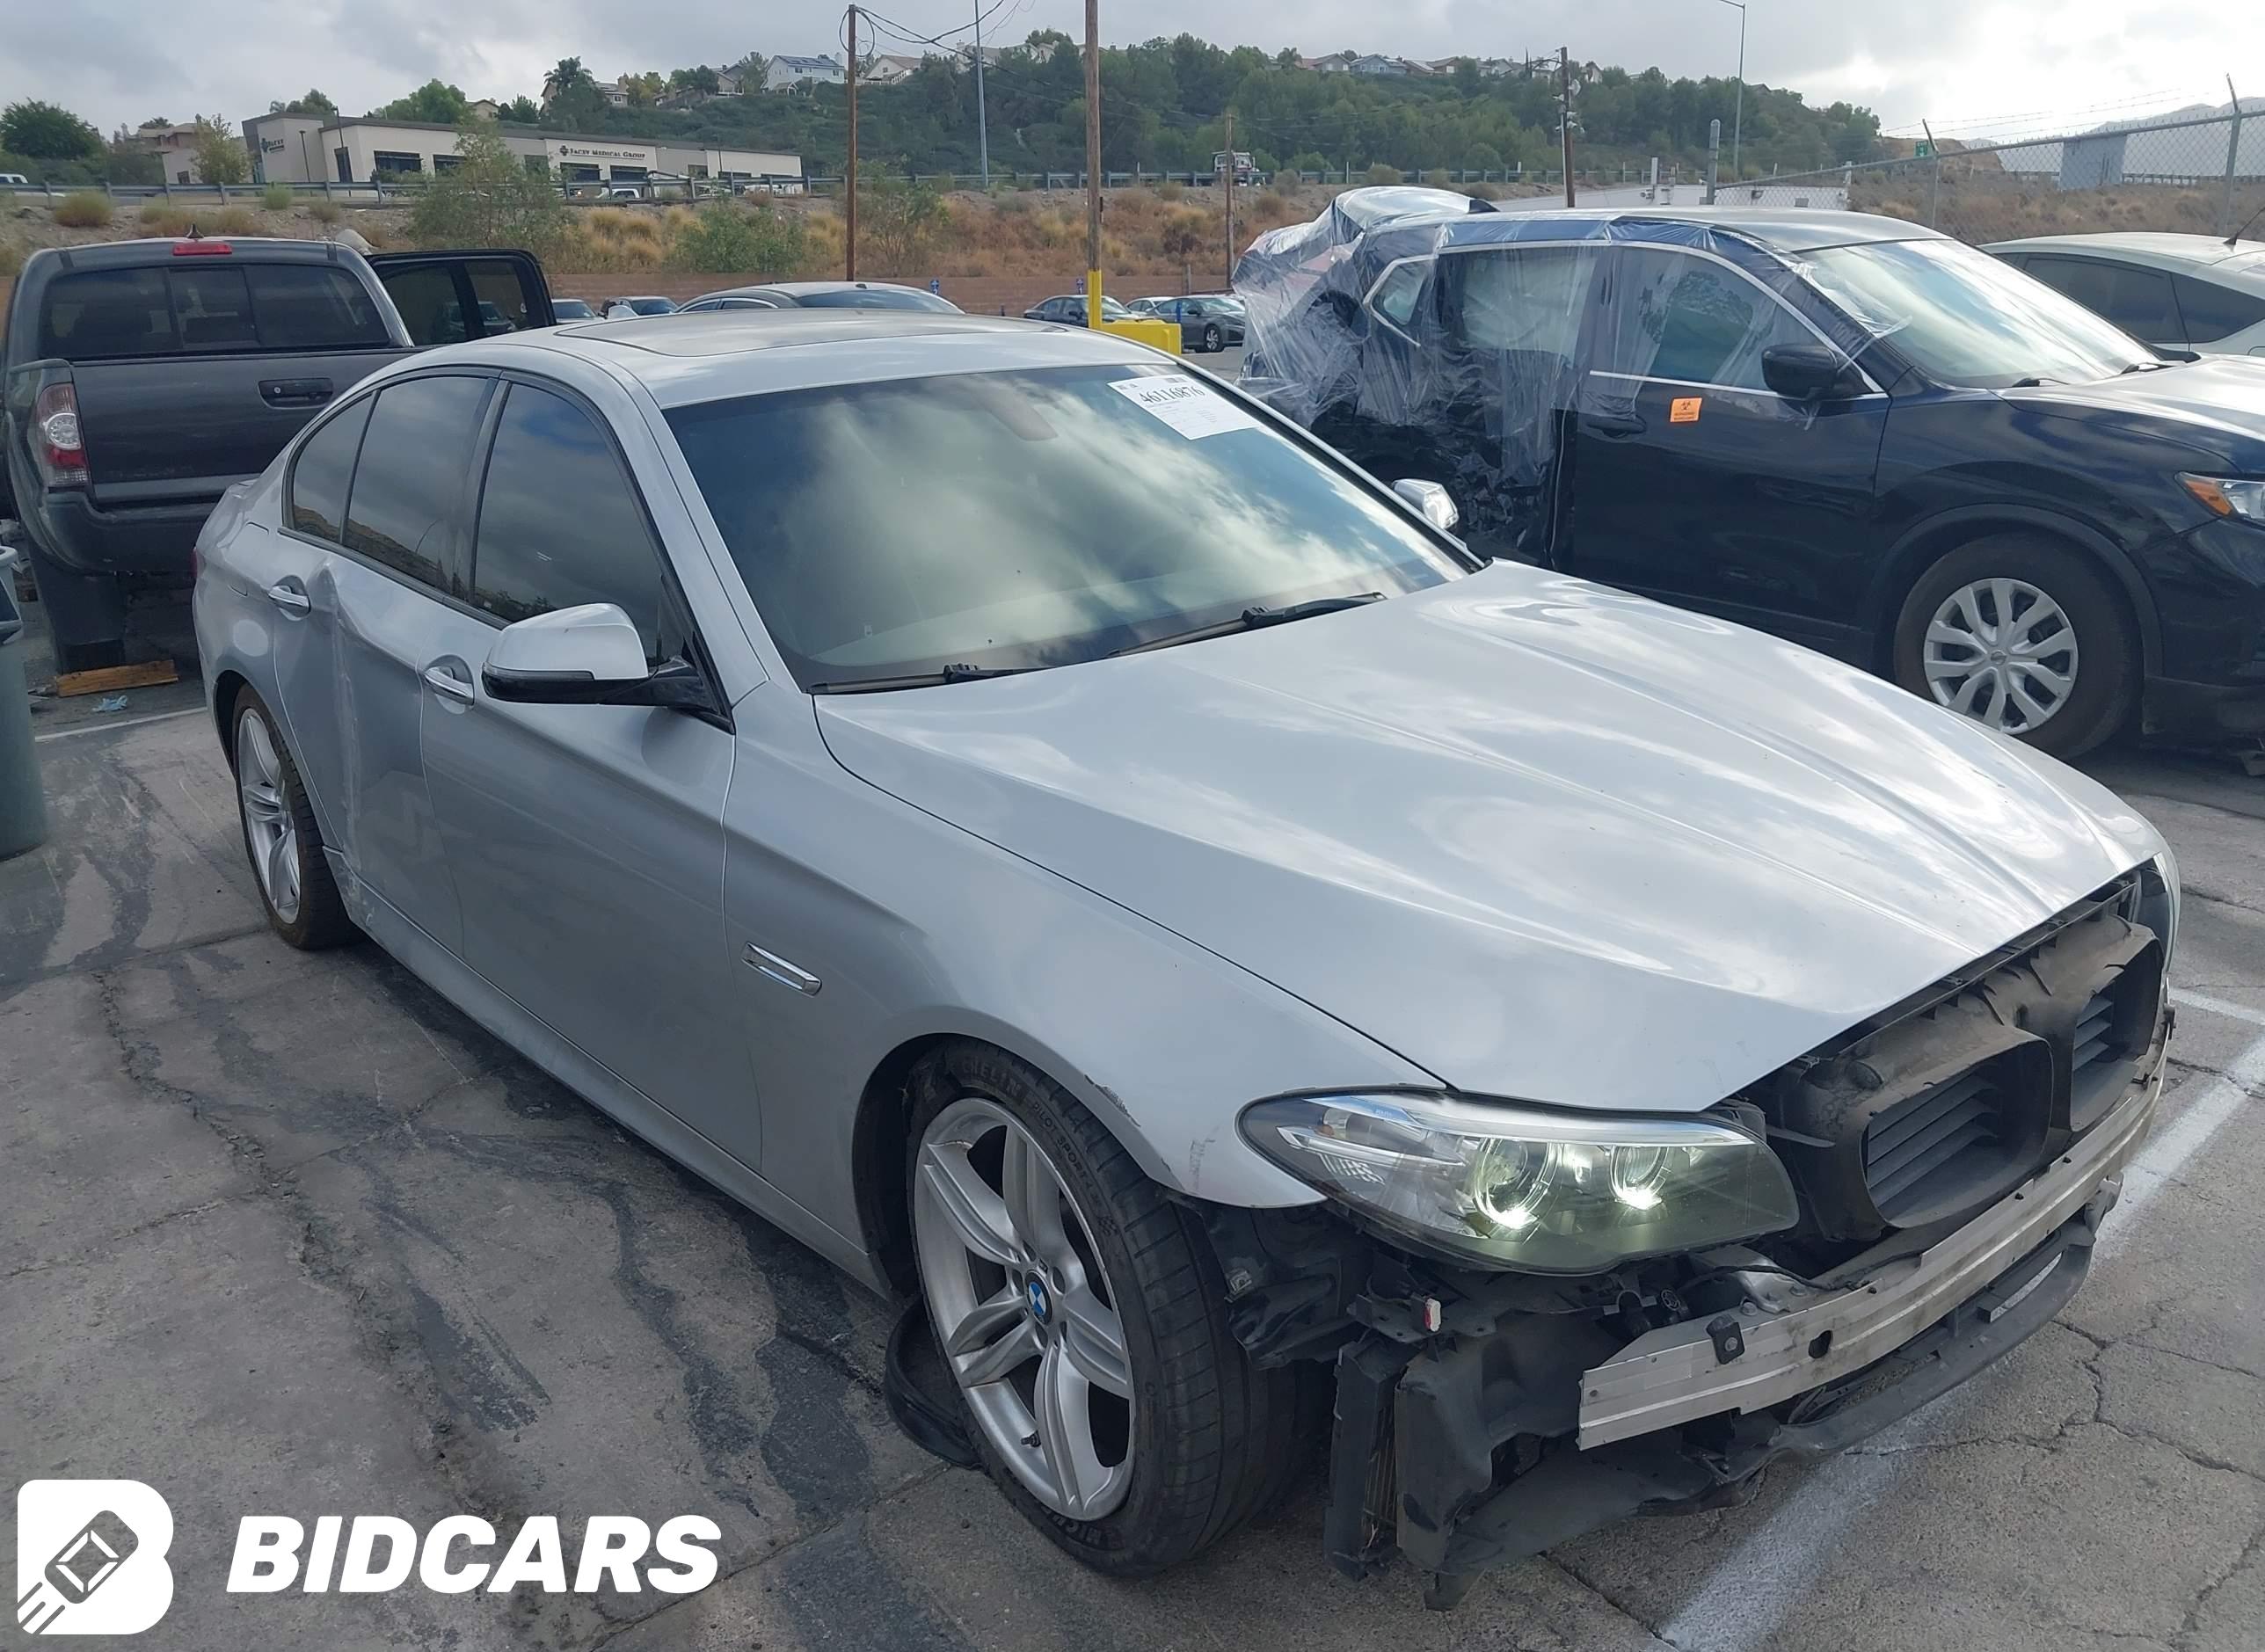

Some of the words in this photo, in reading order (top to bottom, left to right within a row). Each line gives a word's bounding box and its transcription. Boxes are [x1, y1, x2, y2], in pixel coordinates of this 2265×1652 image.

[1140, 386, 1205, 404] 46116876
[1032, 1103, 1058, 1133] PILOT
[1058, 1137, 1087, 1179] SPORT
